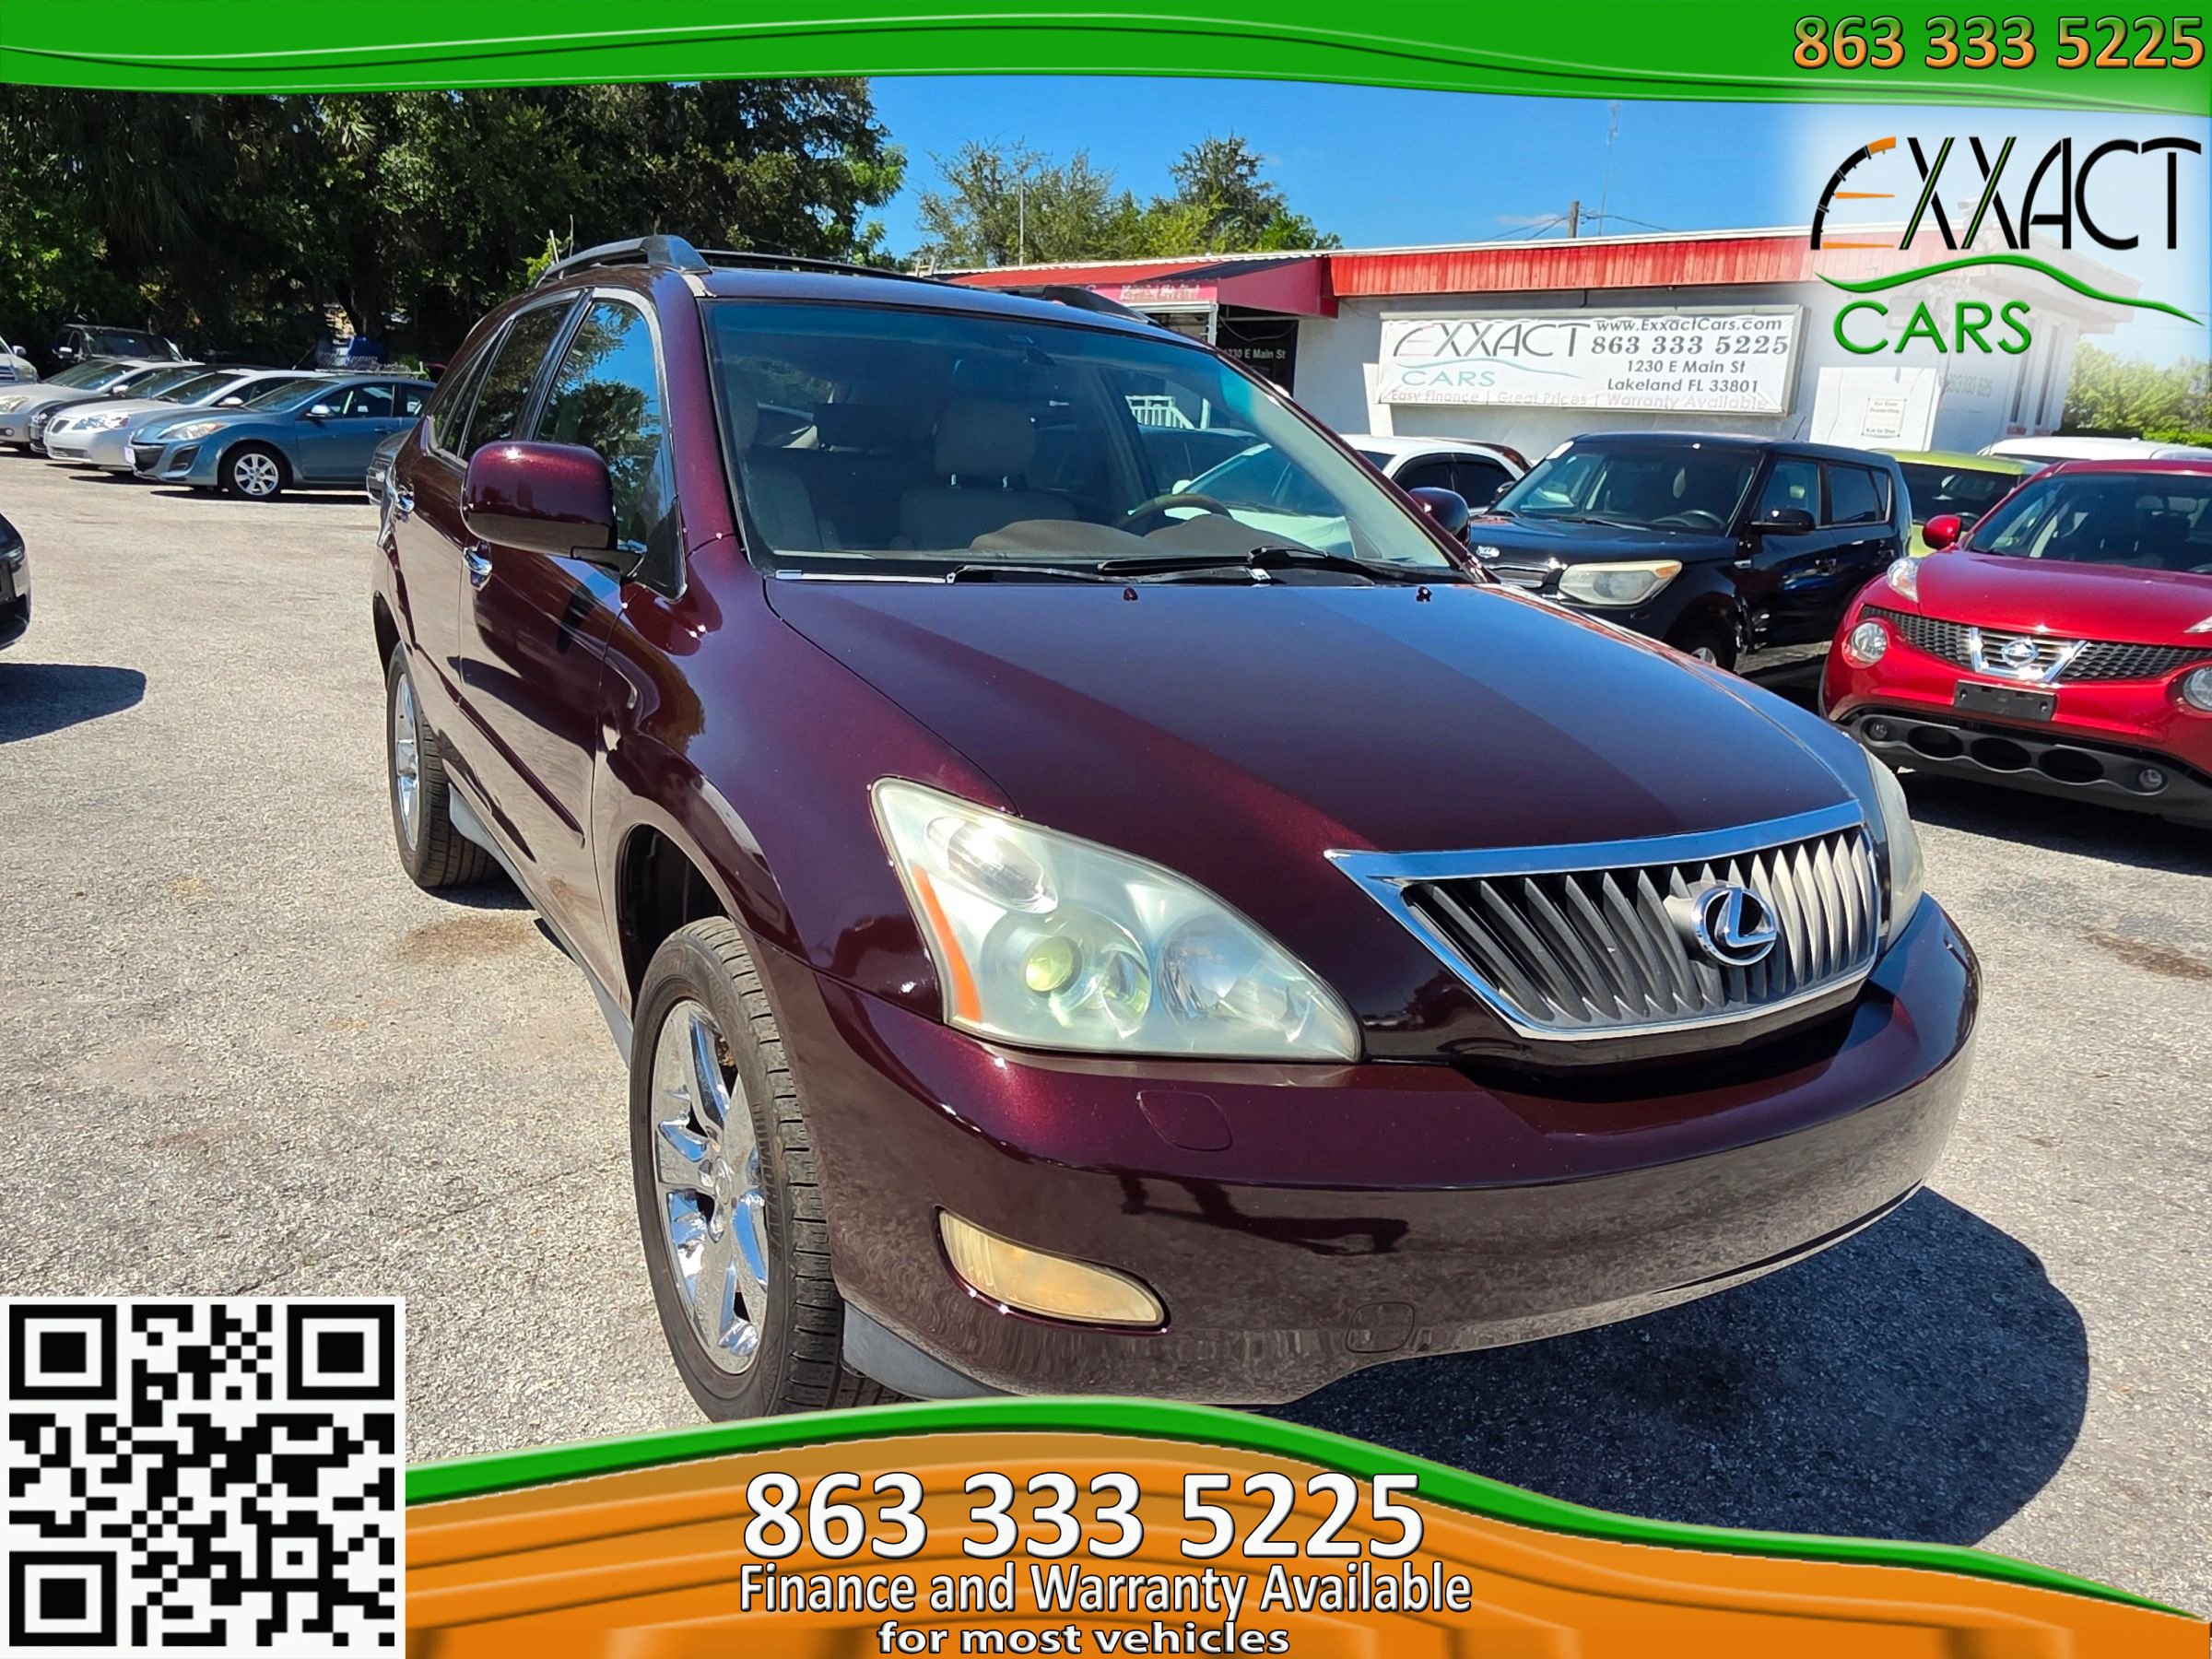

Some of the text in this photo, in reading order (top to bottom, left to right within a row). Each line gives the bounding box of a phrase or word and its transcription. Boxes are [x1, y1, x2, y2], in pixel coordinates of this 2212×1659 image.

[1597, 317, 1783, 332] www.ExxactCars.com
[1393, 323, 1591, 358] EXXACT
[1591, 335, 1789, 355] 863 333 5225
[1244, 348, 1251, 359] E
[1253, 348, 1274, 359] Main
[1275, 349, 1286, 359] St
[1628, 359, 1746, 373] 1230 E Main St
[1401, 371, 1496, 387] CARS
[1607, 378, 1759, 393] Lakeland FL 33801
[1392, 390, 1769, 409] Easy Finance Great Prices Warranty Available
